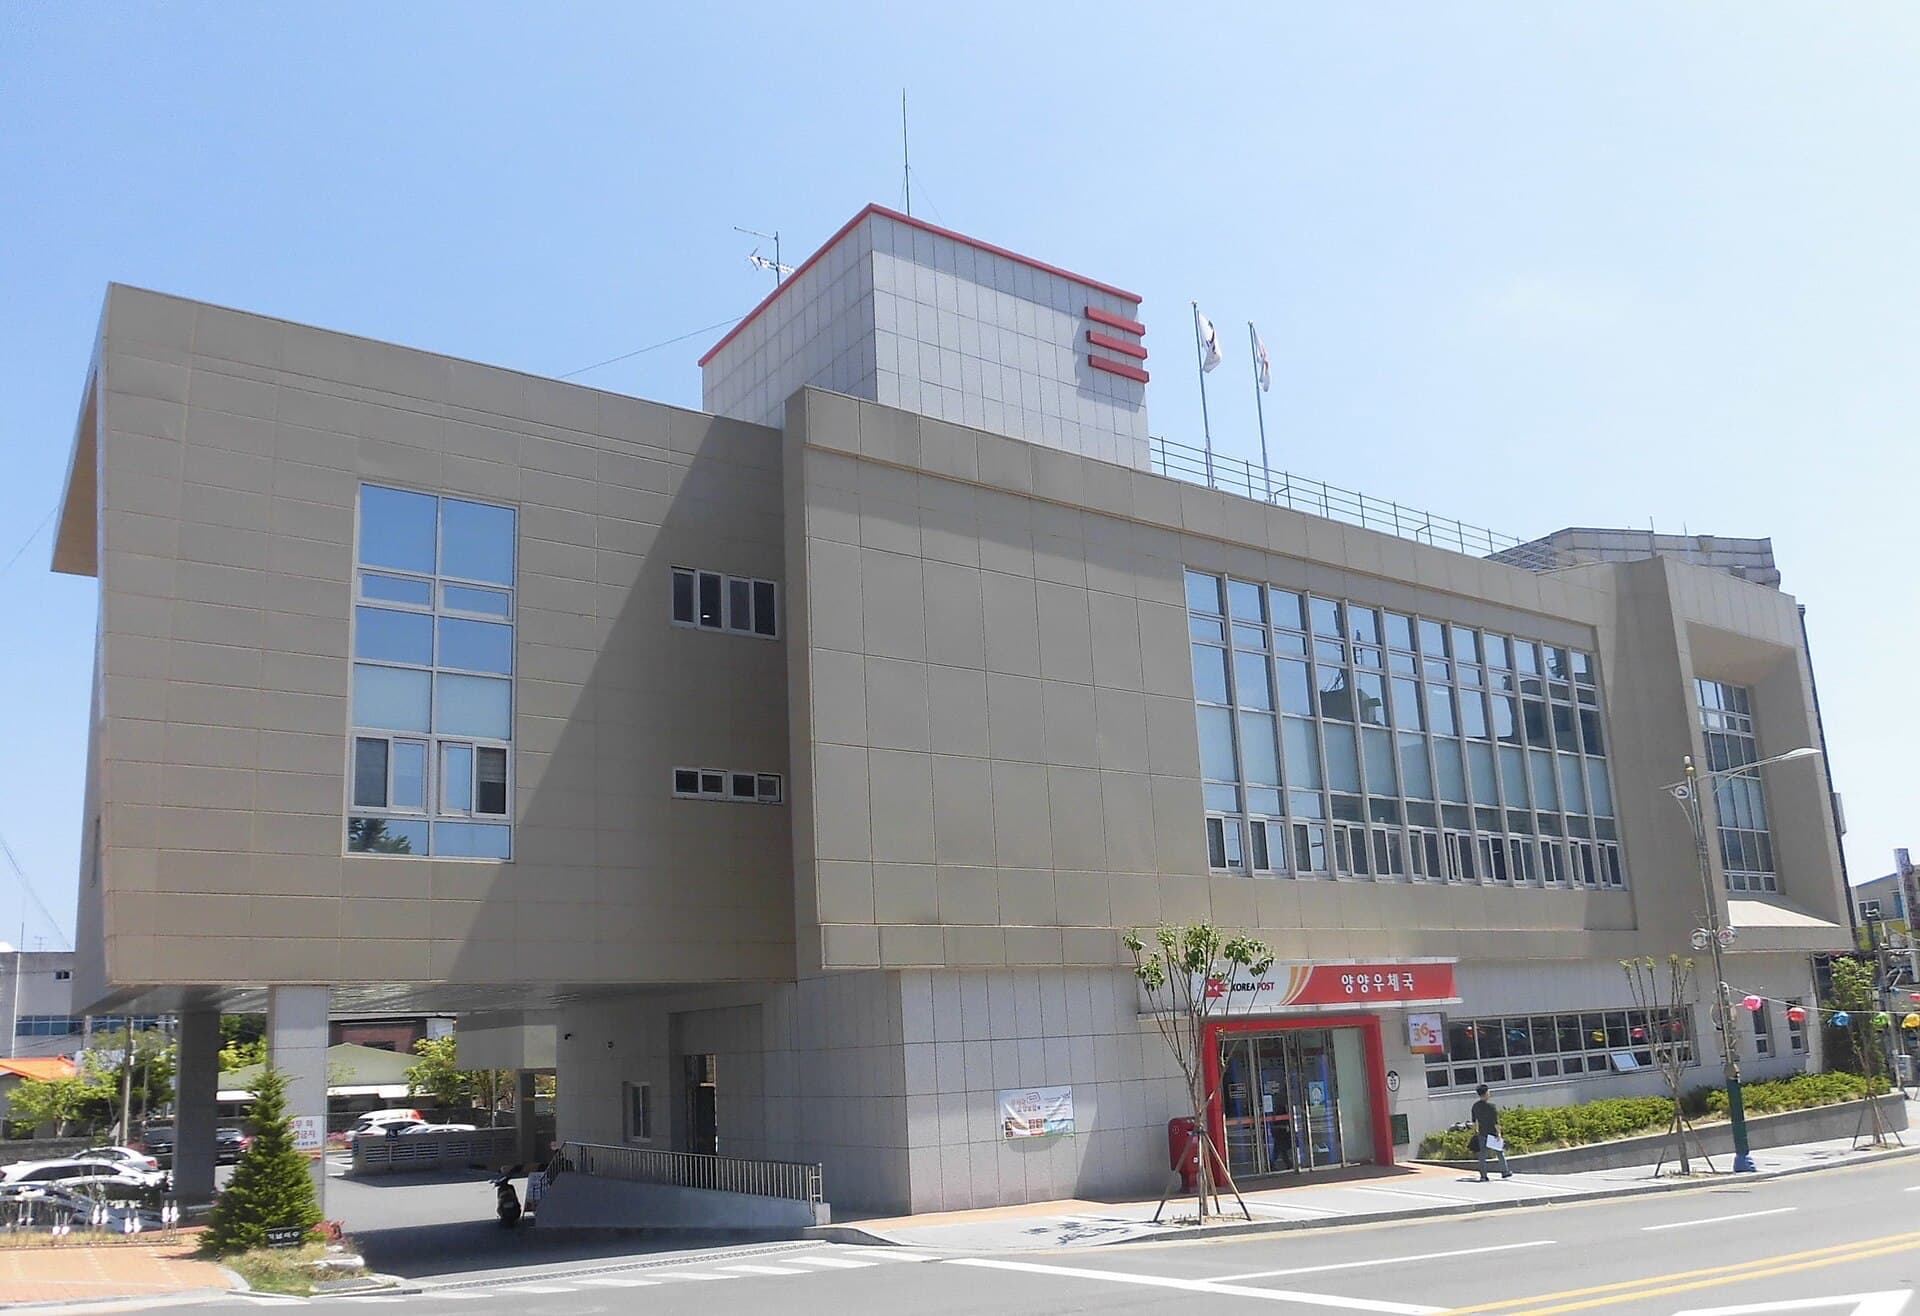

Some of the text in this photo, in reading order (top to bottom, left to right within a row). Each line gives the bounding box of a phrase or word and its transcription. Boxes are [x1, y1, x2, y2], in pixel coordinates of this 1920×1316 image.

[1232, 981, 1275, 992] KOREA POST
[1341, 973, 1414, 994] 양양우체국
[1414, 1023, 1437, 1044] 365
